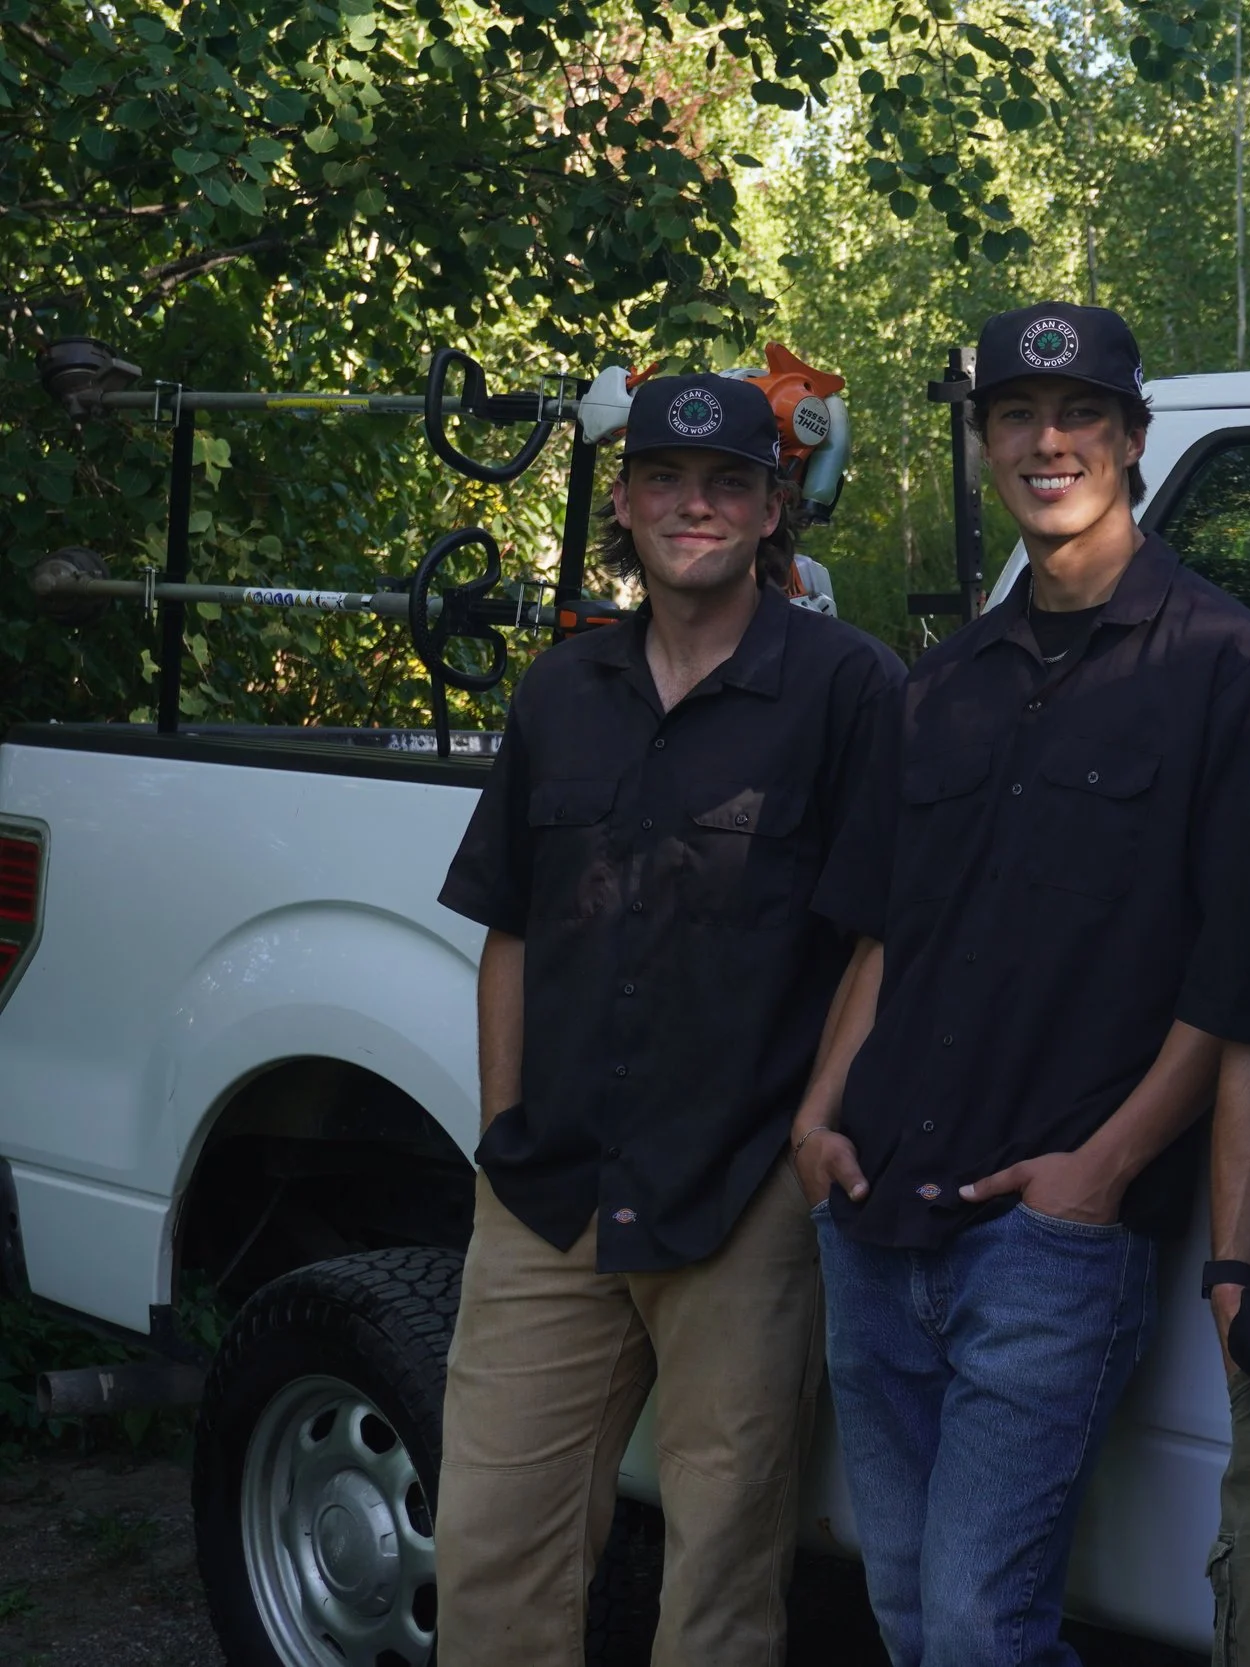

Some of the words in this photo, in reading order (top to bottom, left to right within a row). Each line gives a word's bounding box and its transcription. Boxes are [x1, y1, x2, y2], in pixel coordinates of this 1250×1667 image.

[1026, 320, 1056, 339] CLEAN
[1058, 323, 1075, 339] CUT
[1043, 351, 1072, 367] WORKS
[675, 390, 702, 407] CLEAN
[703, 394, 719, 410] CUT
[672, 416, 689, 433] YARD
[690, 420, 717, 434] WORKS
[797, 414, 827, 437] STIHL
